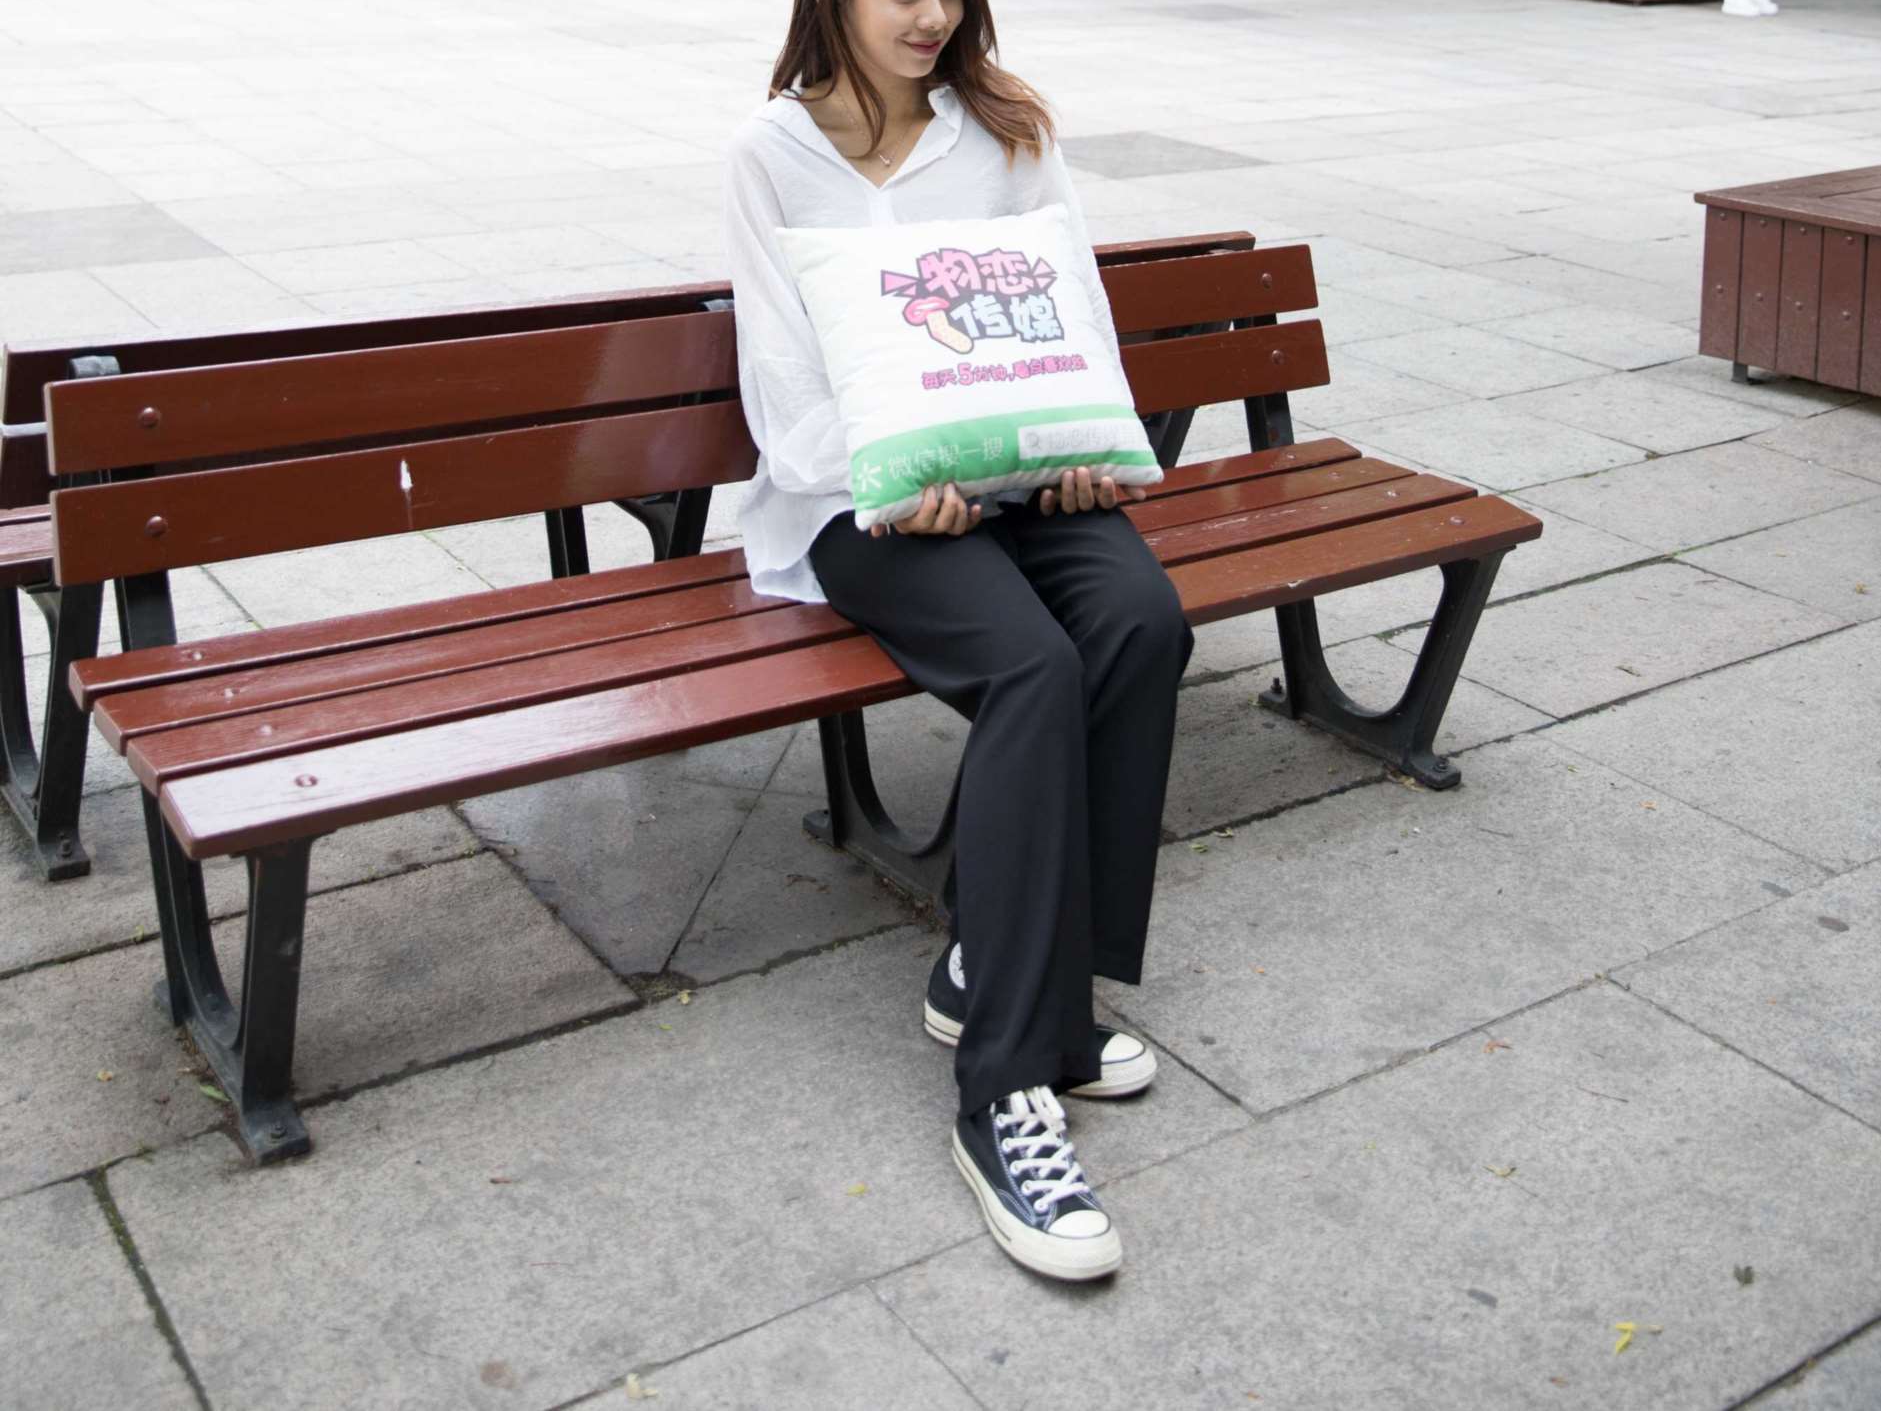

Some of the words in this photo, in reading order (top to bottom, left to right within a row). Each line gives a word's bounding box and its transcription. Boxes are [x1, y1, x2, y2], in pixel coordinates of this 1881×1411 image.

[947, 293, 1065, 342] 传媒
[888, 436, 1004, 479] 微信搜一搜
